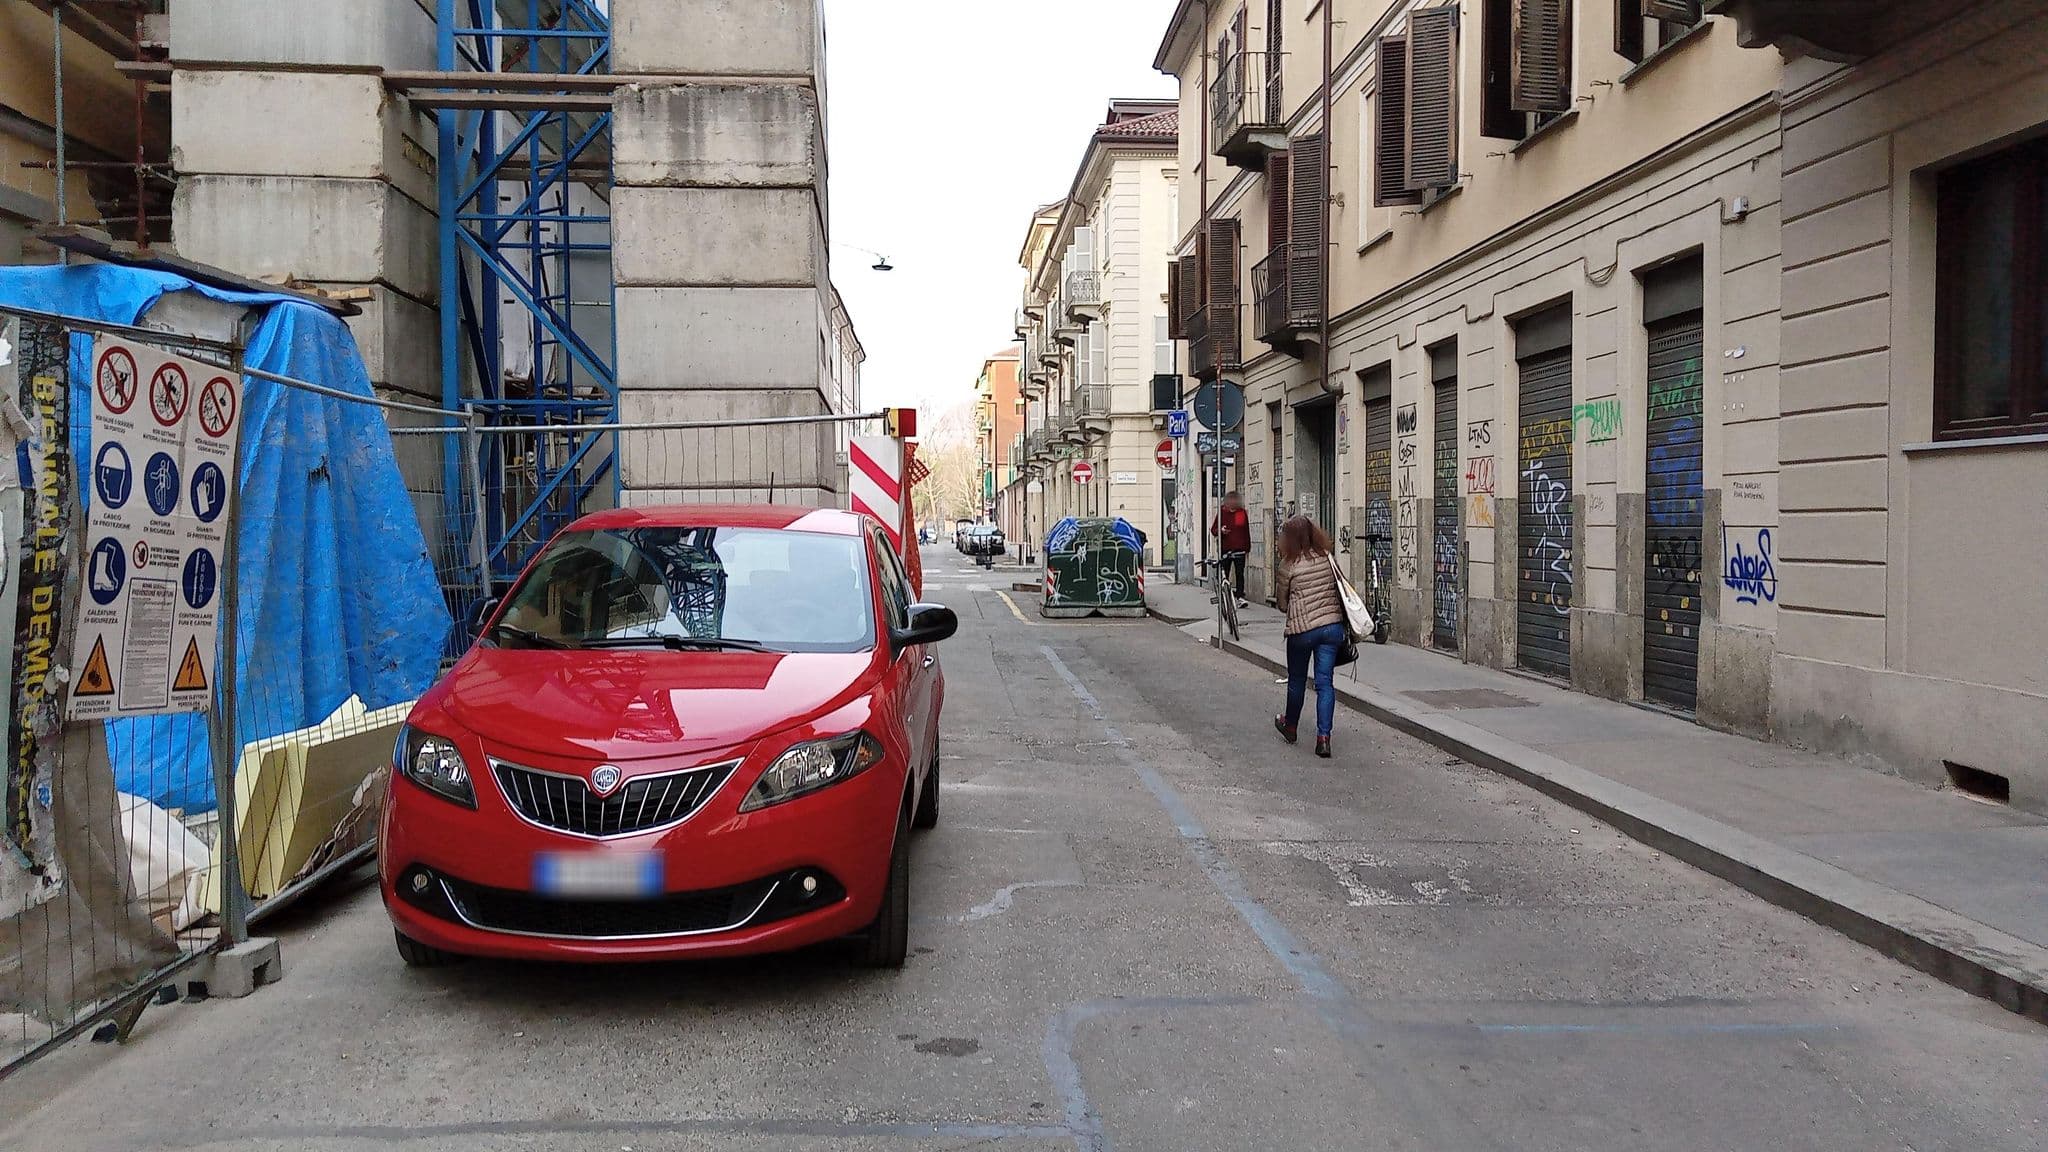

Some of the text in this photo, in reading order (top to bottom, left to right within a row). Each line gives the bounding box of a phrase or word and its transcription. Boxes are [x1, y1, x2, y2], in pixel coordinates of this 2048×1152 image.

[1170, 414, 1186, 433] Park
[103, 512, 122, 520] CASCO
[99, 520, 131, 530] PROTEZIONE
[149, 520, 171, 528] CINTURA
[149, 527, 175, 536] SICUREZZA
[196, 525, 213, 533] GUANTI
[192, 532, 221, 542] PROTEZIONE
[87, 609, 117, 617] CALZATURE
